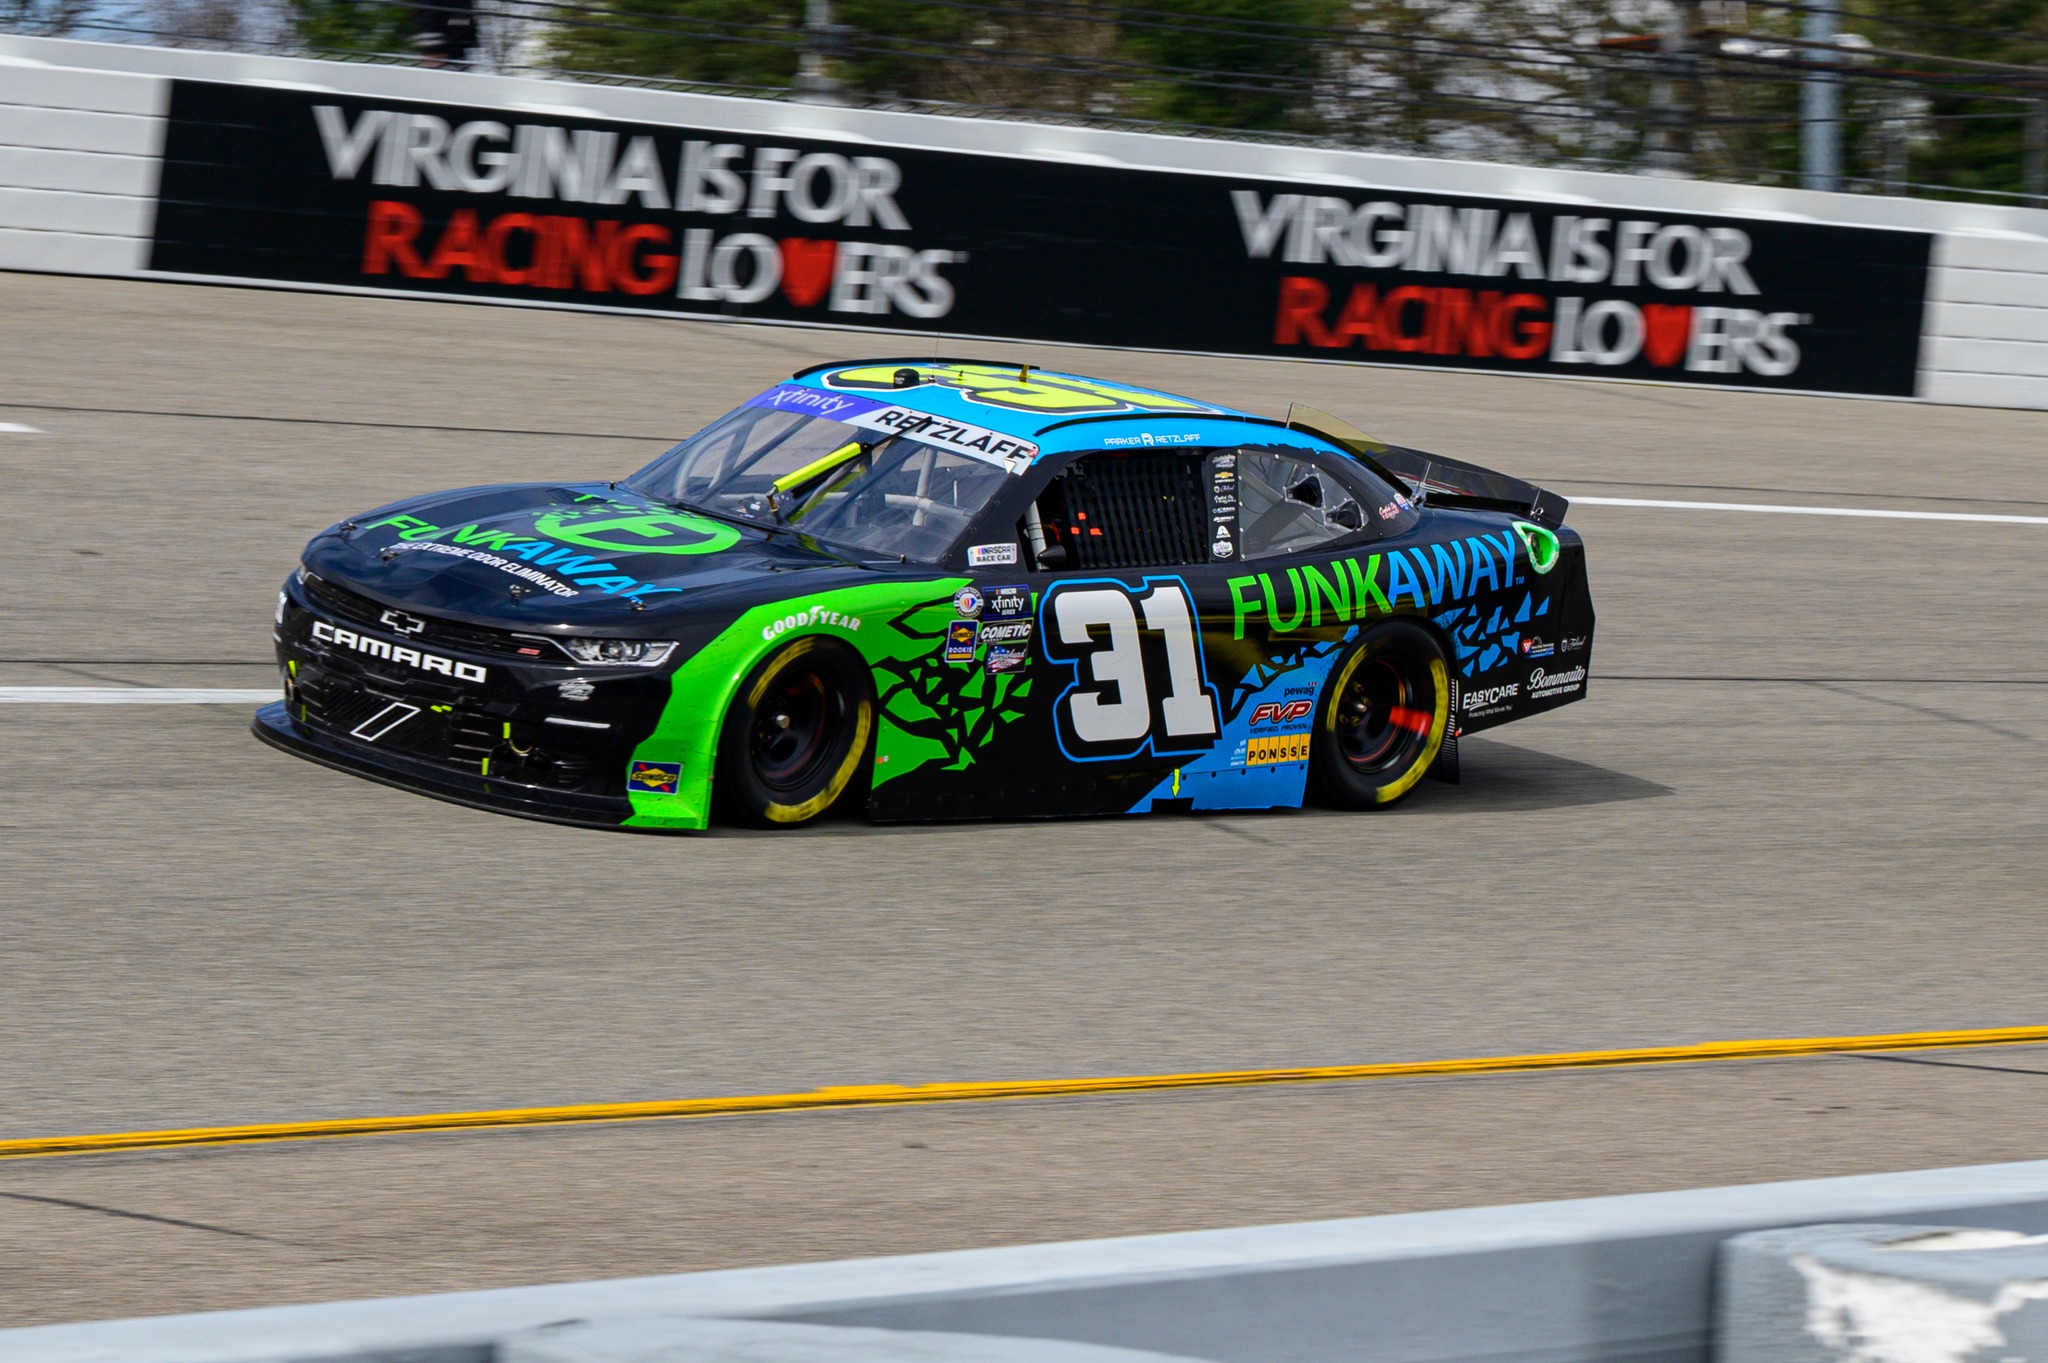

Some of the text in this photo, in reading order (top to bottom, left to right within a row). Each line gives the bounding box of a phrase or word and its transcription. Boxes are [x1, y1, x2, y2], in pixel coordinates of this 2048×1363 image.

[313, 105, 911, 232] VIRGINIA IS FOR
[362, 200, 680, 296] RACING
[1229, 190, 1762, 296] VIRGINIA IS FOR
[1274, 276, 1553, 360] RACING
[769, 389, 1031, 462] xfinity RETZLAFF
[1103, 437, 1141, 445] PARKER
[1154, 434, 1200, 443] RETZLAFF
[365, 514, 684, 599] FUNKAWAY
[983, 545, 1011, 554] NASCAR
[997, 554, 1011, 562] CAR
[411, 542, 473, 558] EXTREME
[467, 550, 508, 567] ODOR
[501, 562, 580, 598] ELIMINATOR
[1227, 530, 1516, 640] FUNKAWAY
[991, 596, 1024, 612] xfinity
[762, 606, 861, 640] GOODYEAR
[980, 623, 1032, 640] COMETIC
[312, 620, 488, 684] CAMARO
[948, 646, 973, 654] ROOKIE
[1055, 586, 1216, 742] 31
[1284, 686, 1315, 698] pewag
[1526, 665, 1586, 690] Bommarito
[1531, 683, 1580, 699] AUTOMOTIVE GROUP
[1249, 699, 1312, 726] FVP
[1248, 745, 1308, 761] PONSSE
